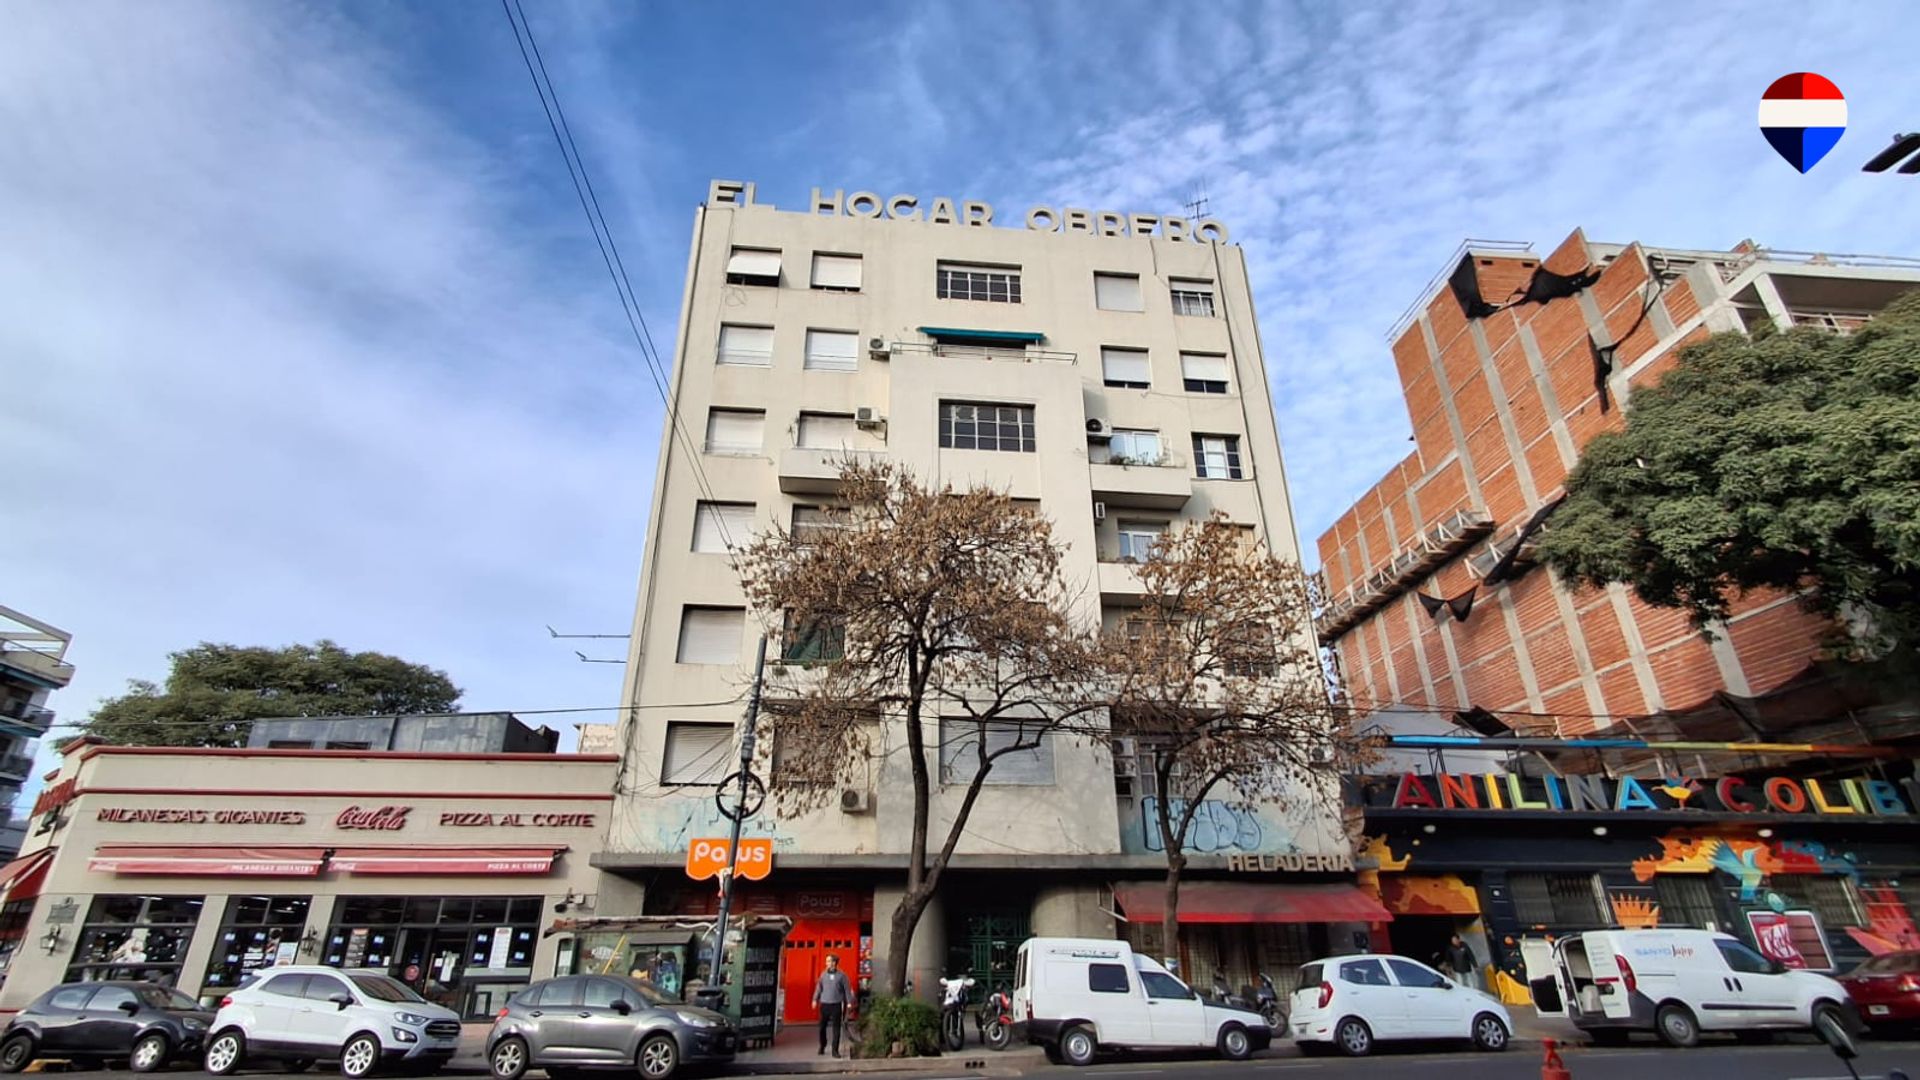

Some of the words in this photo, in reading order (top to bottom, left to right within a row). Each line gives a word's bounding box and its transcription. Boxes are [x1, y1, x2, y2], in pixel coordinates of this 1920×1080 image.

[708, 179, 776, 210] EL
[811, 186, 993, 228] HOGAR
[1027, 206, 1230, 246] OBRERO
[1392, 772, 1659, 812] ANILINA
[1716, 776, 1920, 817] COLIB
[97, 808, 208, 824] MILANESAS
[214, 810, 307, 825] GIGANTES
[440, 813, 494, 827] PIZZA
[500, 813, 525, 827] AL
[532, 813, 596, 828] CORTE
[1227, 853, 1356, 872] HELADERIA
